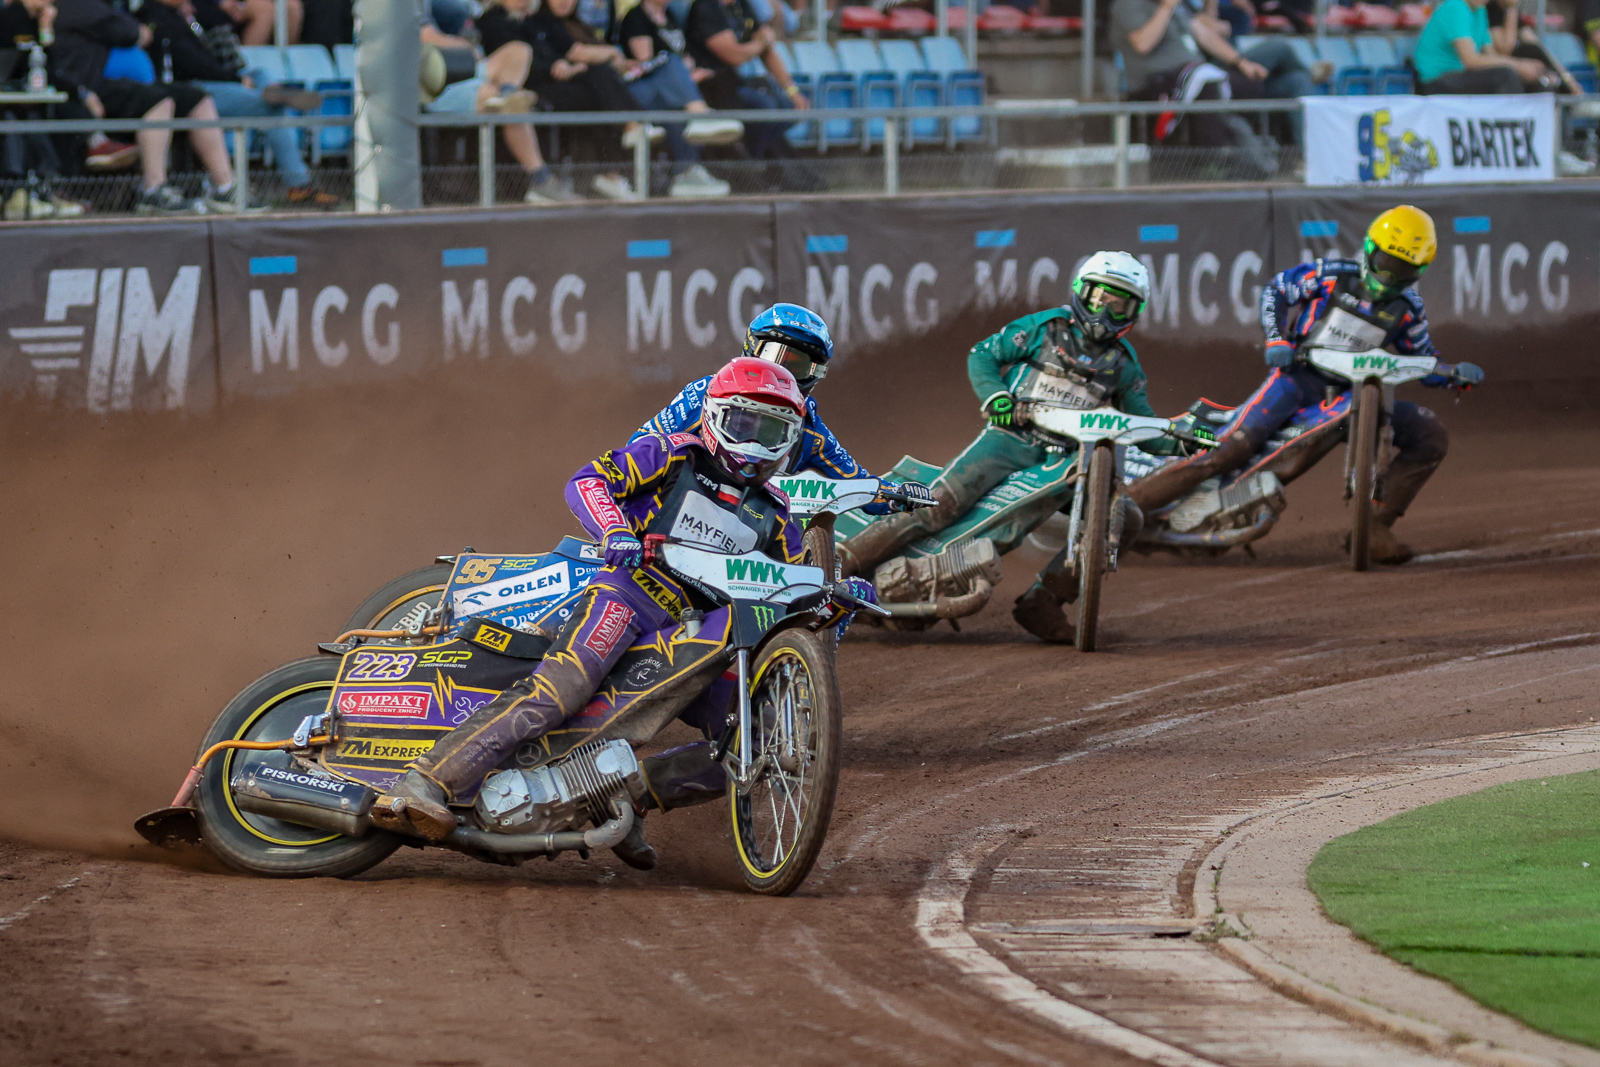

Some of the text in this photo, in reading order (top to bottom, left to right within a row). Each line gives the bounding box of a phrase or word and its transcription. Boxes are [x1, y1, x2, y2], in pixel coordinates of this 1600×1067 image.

[1447, 117, 1540, 168] BARTEK
[1139, 250, 1263, 331] MCG
[1453, 241, 1570, 318] MCG
[626, 267, 766, 352] MCG
[806, 262, 939, 344] MCG
[249, 283, 401, 375] MCG
[442, 274, 588, 361] MCG
[1353, 355, 1398, 371] WWK
[1080, 413, 1132, 431] WWK
[695, 473, 719, 491] FIM
[780, 479, 838, 501] WWK
[455, 558, 504, 584] 95
[501, 559, 538, 568] SGP
[726, 559, 788, 587] WWK
[498, 572, 562, 597] ORLEN
[728, 585, 762, 593] SCHWAIGER
[480, 628, 507, 645] TM
[345, 652, 418, 682] 223
[419, 651, 473, 663] SGP
[360, 695, 425, 707] IMPAKT
[341, 741, 430, 758] TM EXPRESS
[261, 767, 346, 792] PISKORSKI
